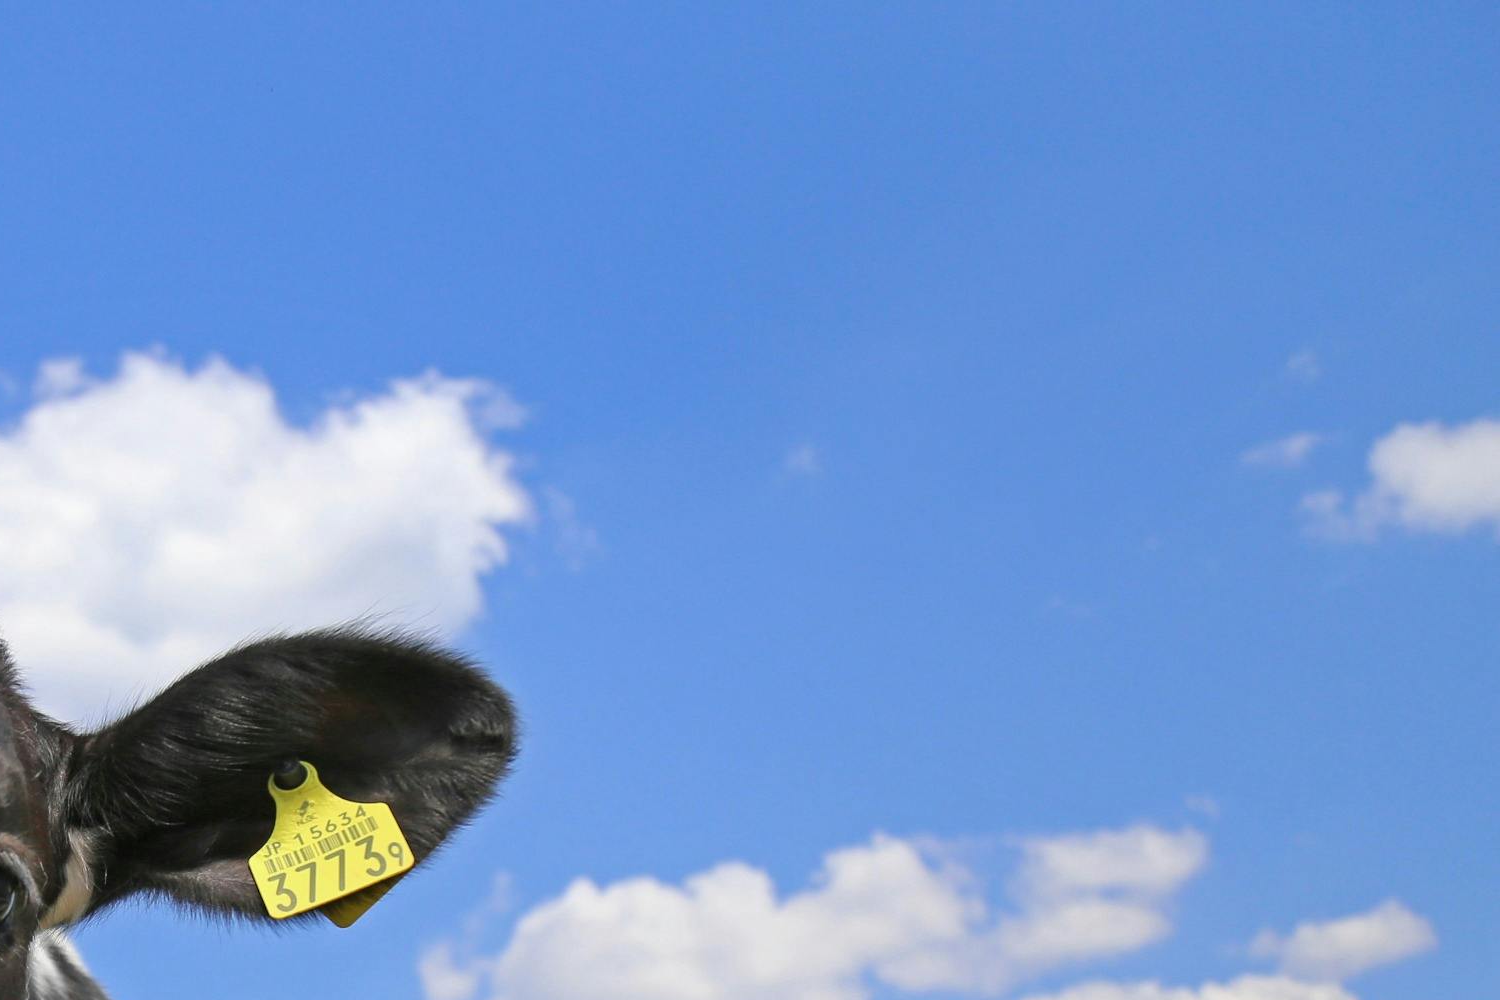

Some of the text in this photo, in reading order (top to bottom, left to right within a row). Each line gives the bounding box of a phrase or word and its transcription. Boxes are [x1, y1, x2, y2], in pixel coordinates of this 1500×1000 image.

[264, 841, 282, 858] JP
[294, 805, 367, 845] 15634
[268, 835, 404, 912] 37739
